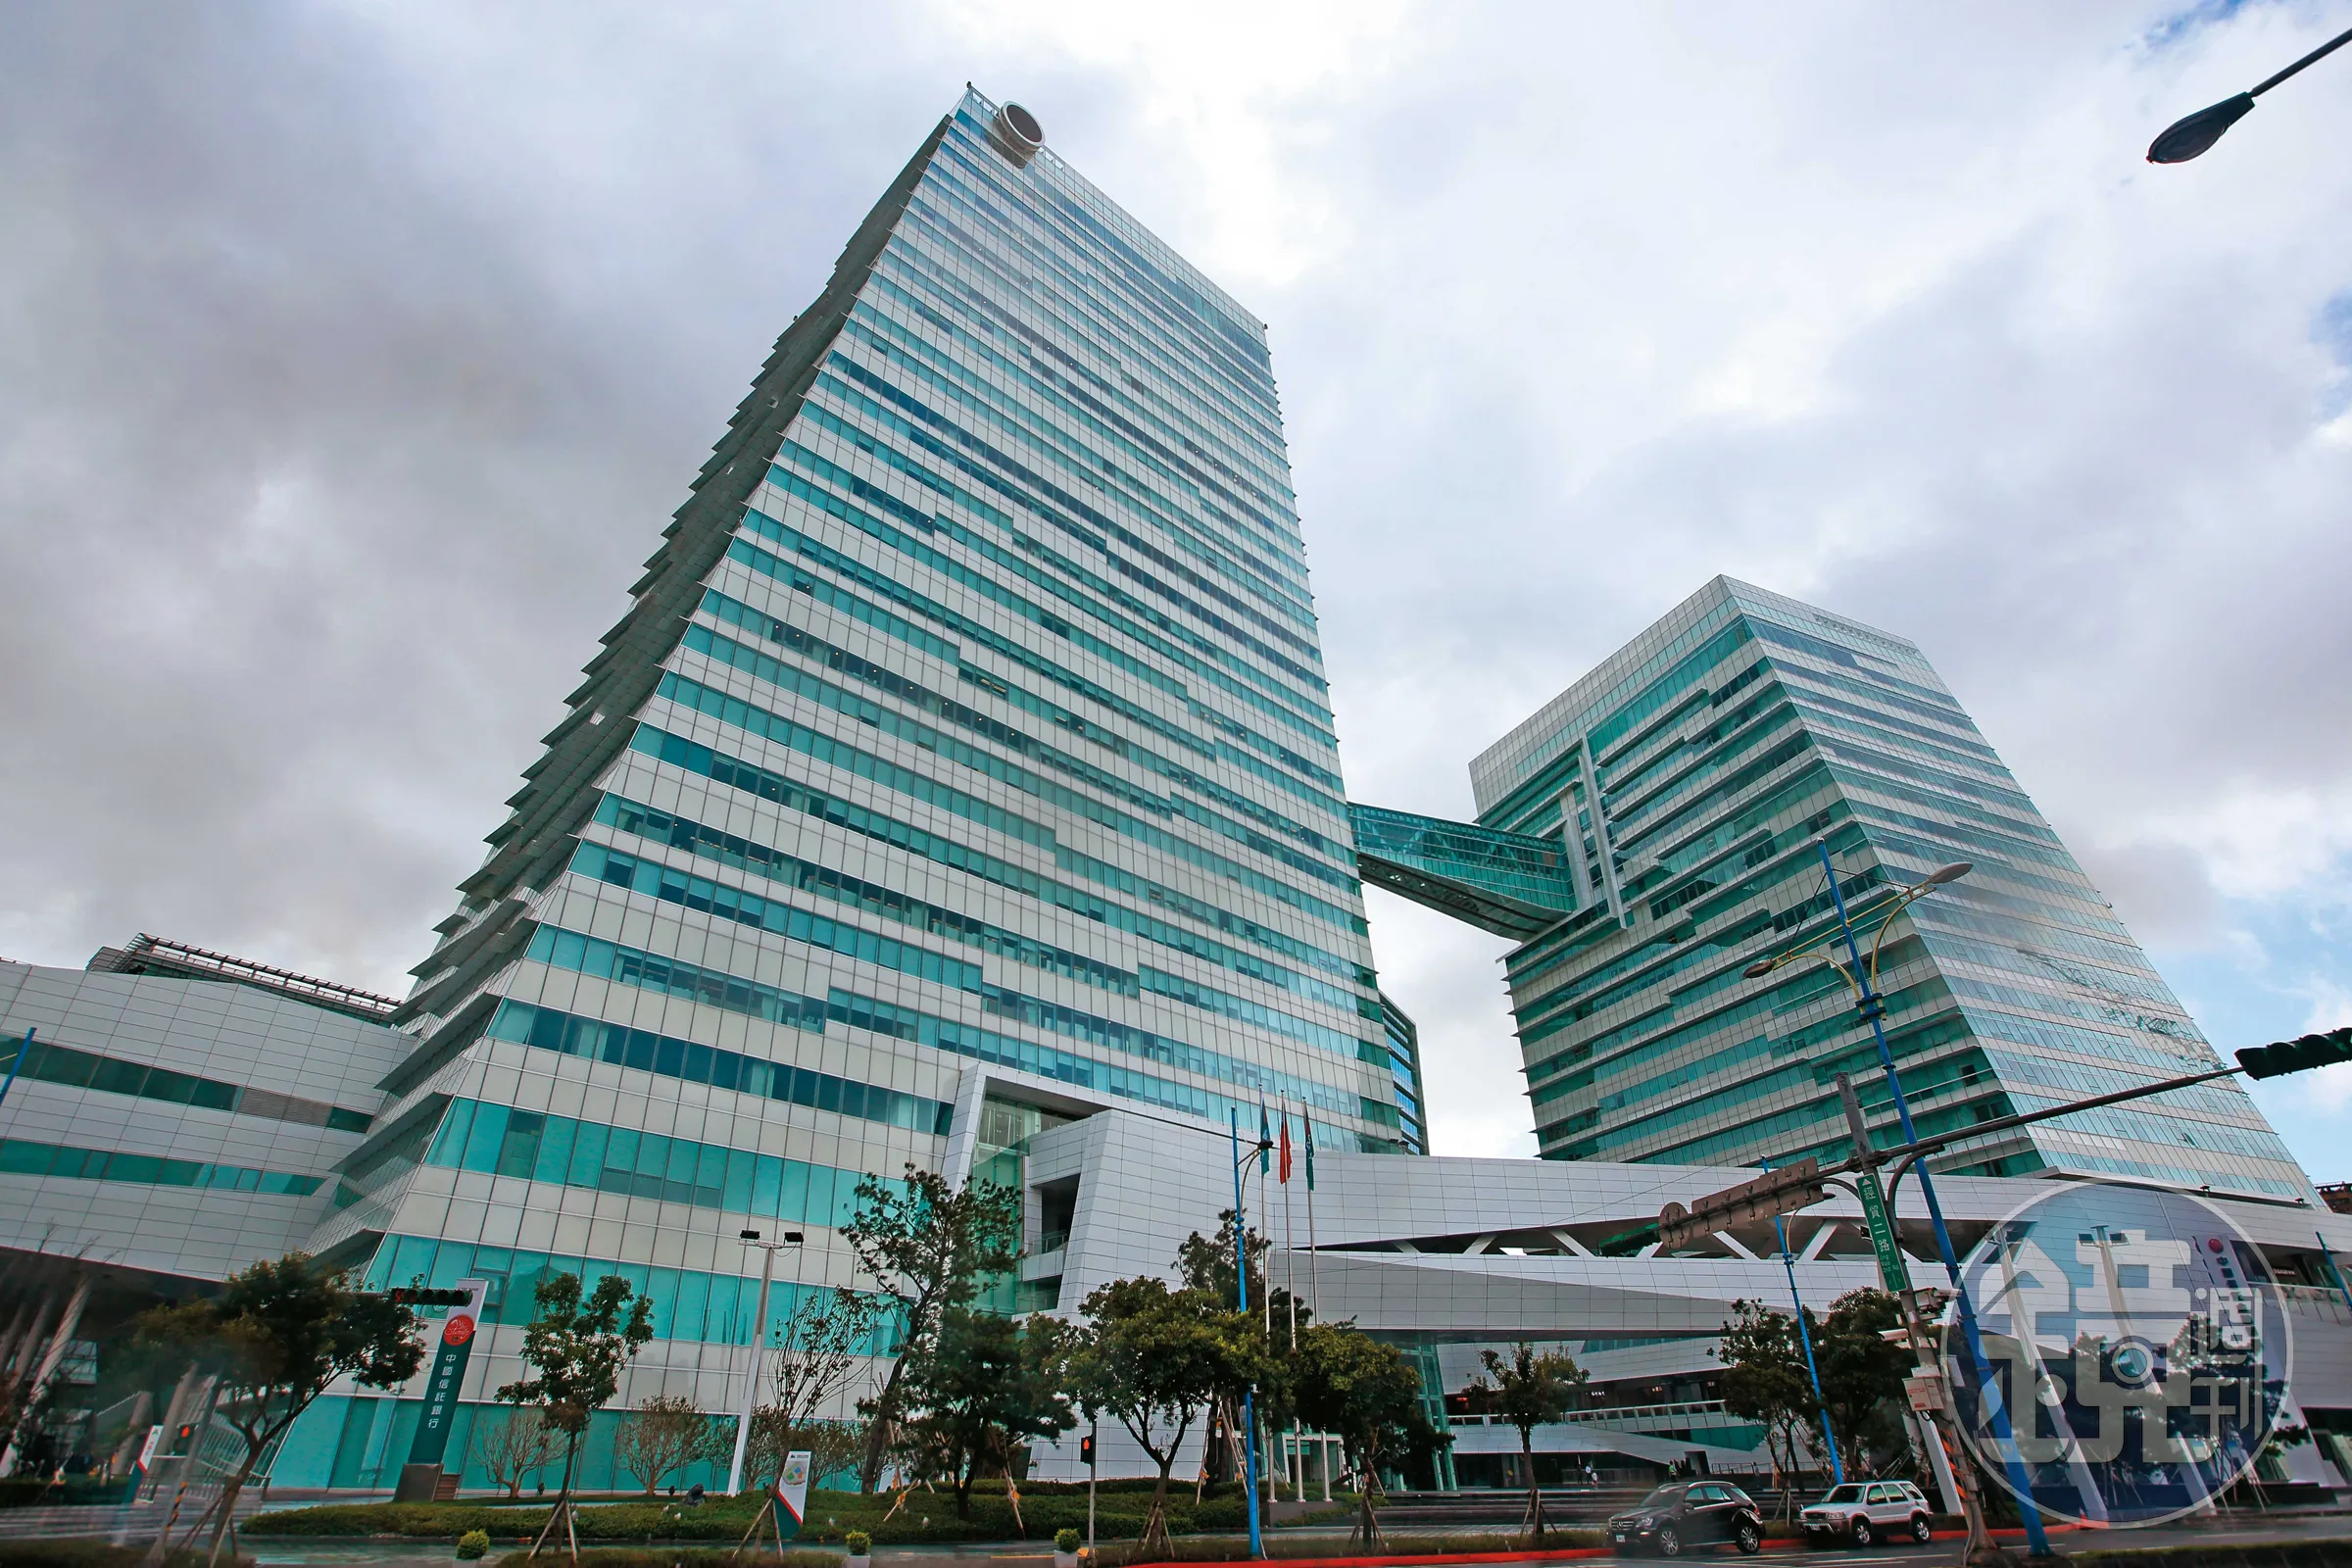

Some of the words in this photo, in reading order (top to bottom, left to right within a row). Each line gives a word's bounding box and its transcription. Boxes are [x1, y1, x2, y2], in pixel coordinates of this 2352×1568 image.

[1863, 1186, 1890, 1252] 經貿二路
[427, 1353, 457, 1429] 中國信託銀行
